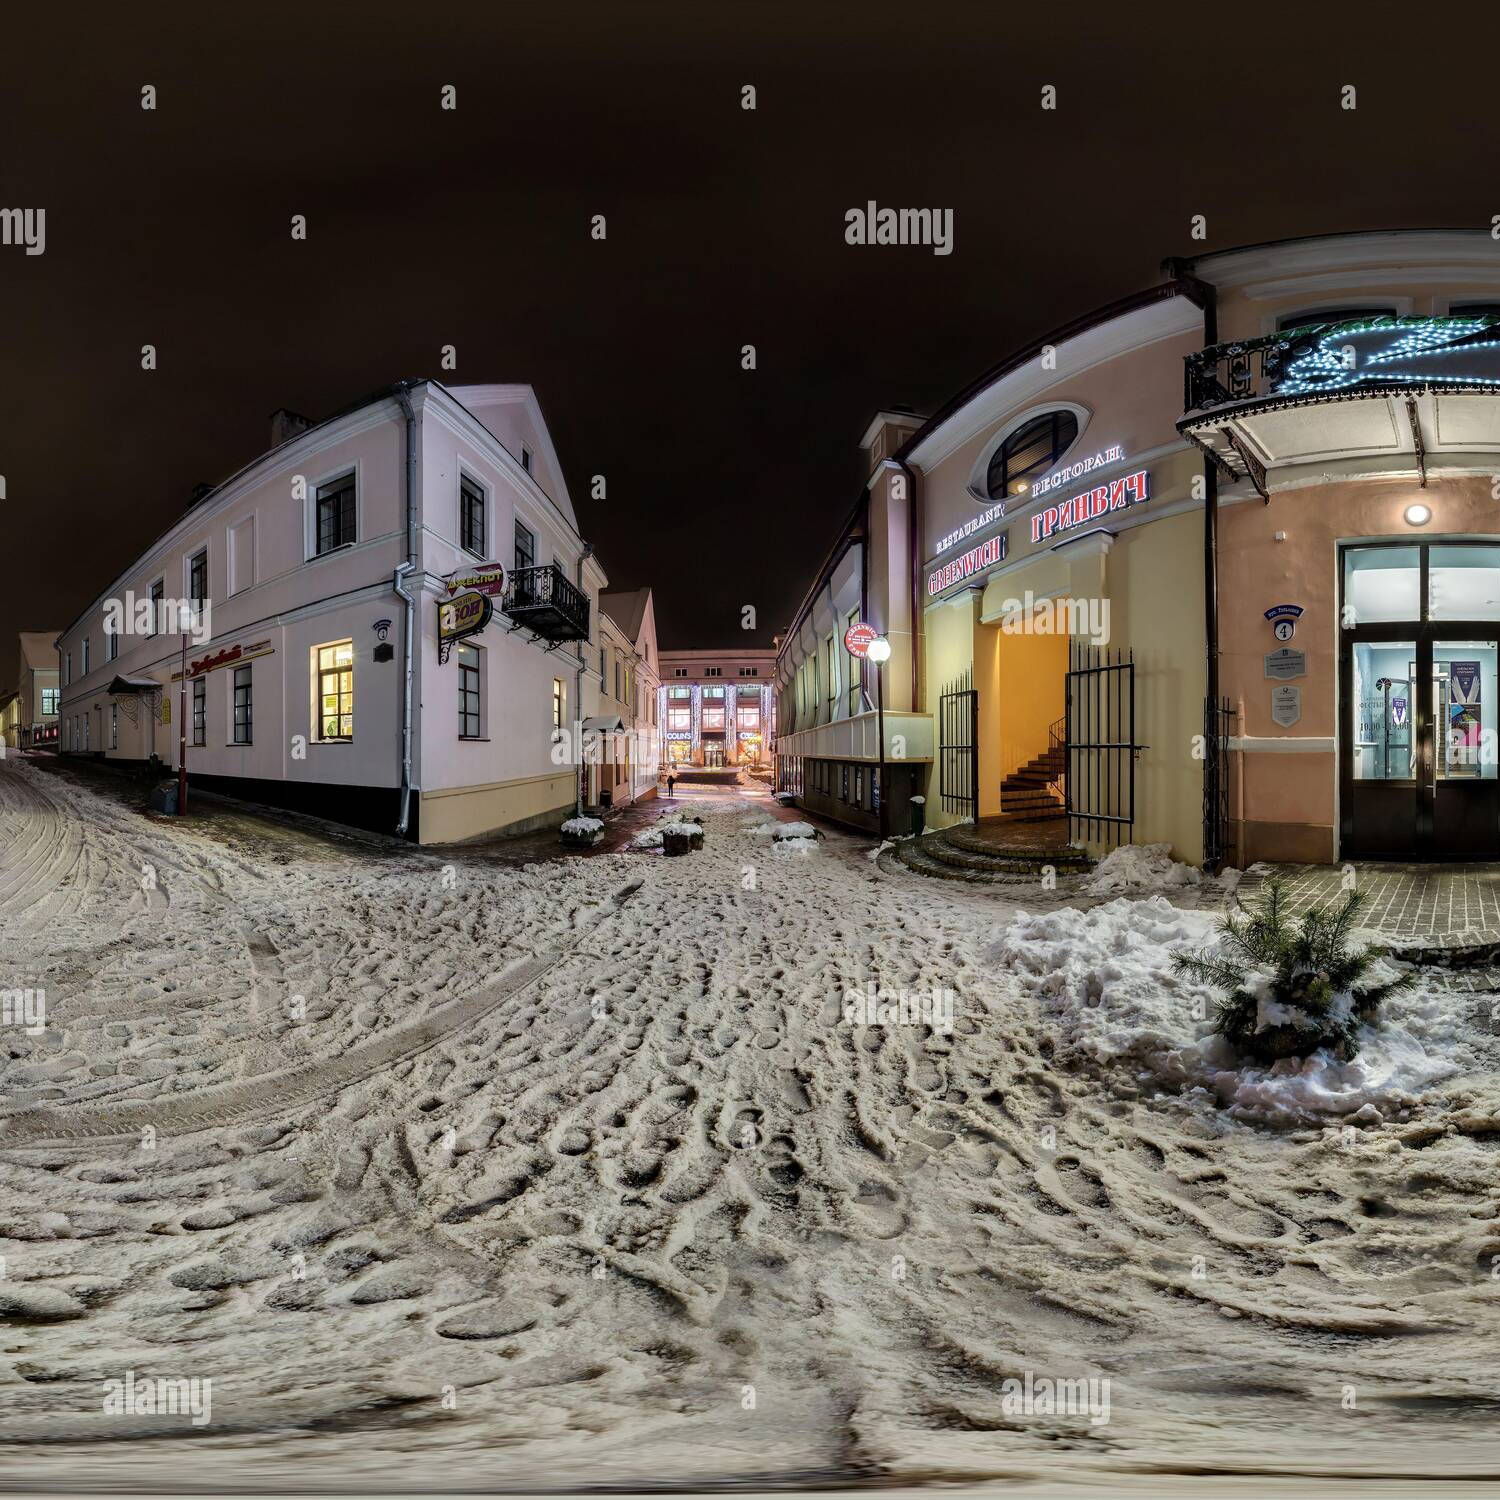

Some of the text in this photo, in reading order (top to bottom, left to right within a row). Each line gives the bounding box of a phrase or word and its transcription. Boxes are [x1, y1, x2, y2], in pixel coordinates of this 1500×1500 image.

[1031, 446, 1121, 497] РЕСТОРАН
[936, 504, 1002, 554] RESTAURANT
[1031, 471, 1148, 543] ГРИНВИЧ
[928, 536, 1001, 595] GREENWICH
[1280, 625, 1287, 638] 4
